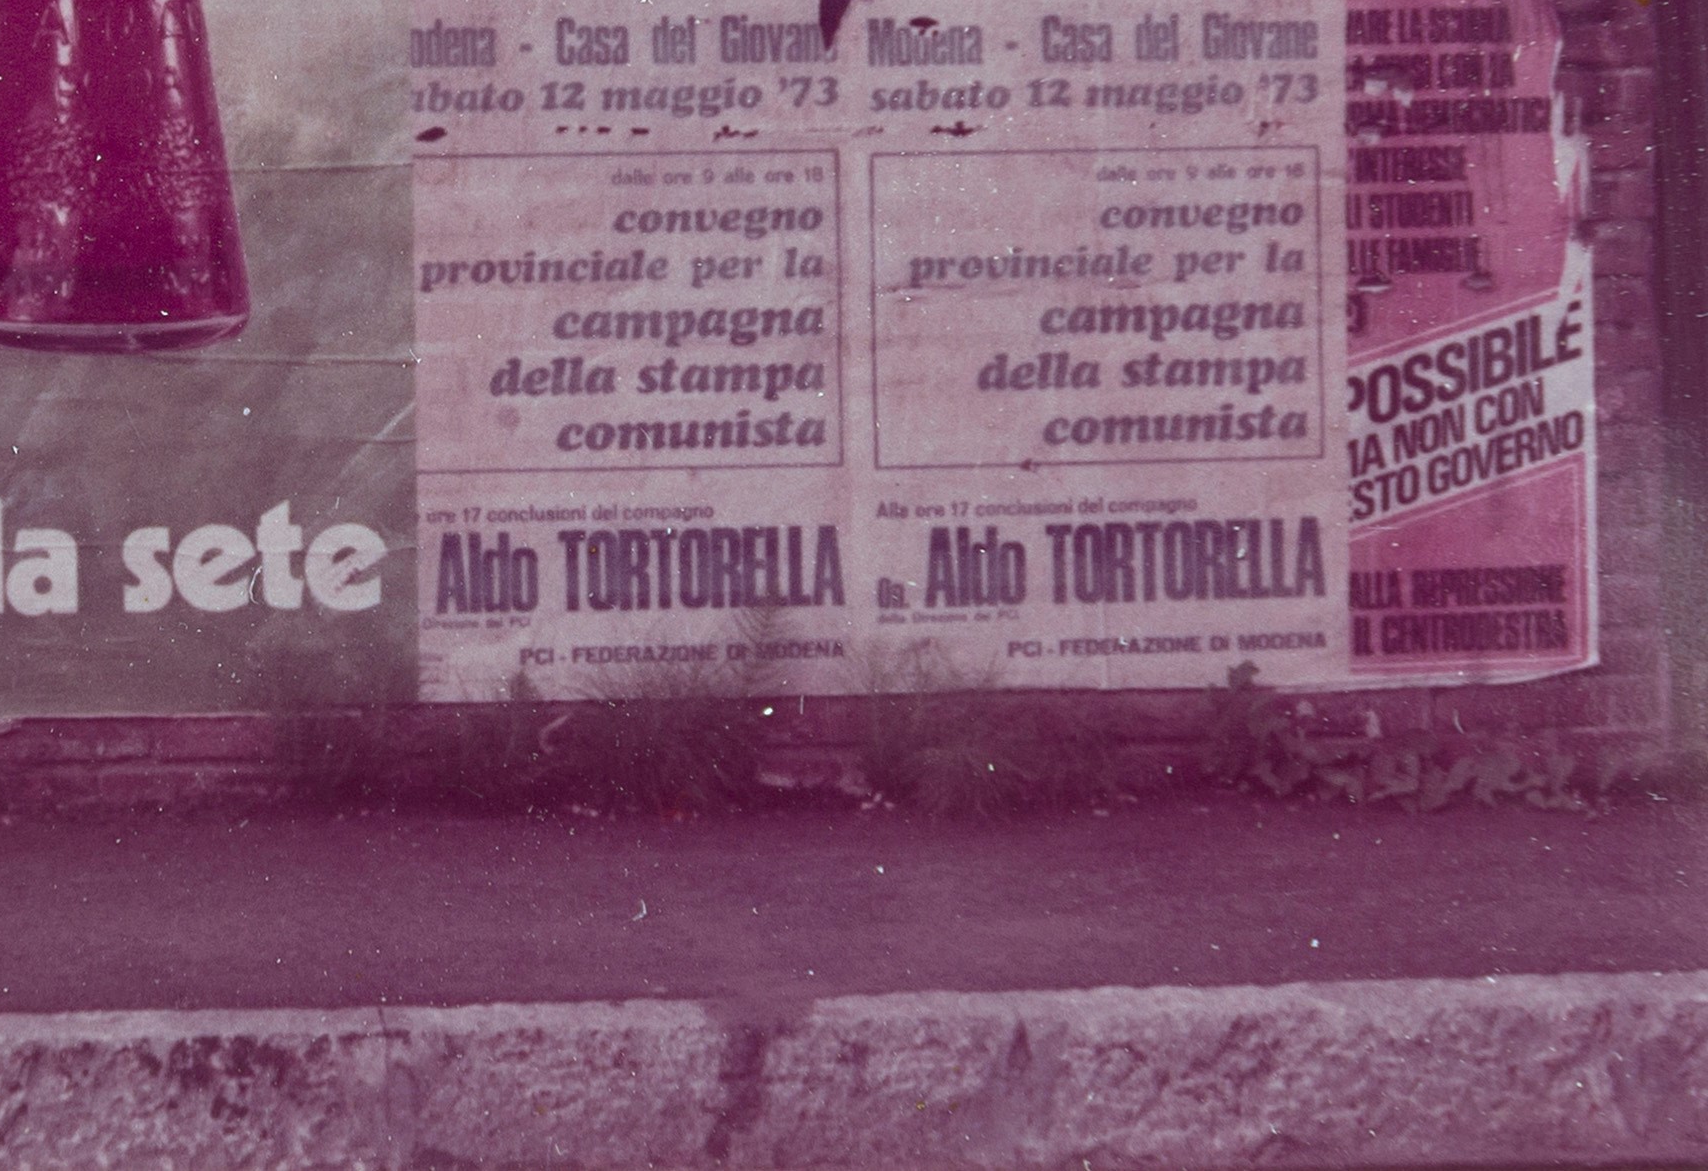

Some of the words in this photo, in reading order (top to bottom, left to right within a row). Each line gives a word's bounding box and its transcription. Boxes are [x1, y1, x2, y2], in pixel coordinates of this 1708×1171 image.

[555, 16, 629, 66] Casa
[652, 16, 696, 65] del
[1041, 15, 1113, 64] Casa
[1136, 14, 1179, 62] del
[1202, 12, 1318, 60] Giovane
[540, 81, 586, 111] 12
[602, 79, 763, 117] maggio
[870, 80, 1011, 112] sabato
[1026, 78, 1071, 109] 12
[1085, 75, 1245, 114] maggio
[612, 205, 824, 239] convegno
[1100, 201, 1305, 235] convegno
[420, 250, 669, 293] provinciale
[691, 254, 763, 289] per
[784, 247, 824, 279] la
[910, 245, 1153, 289] provinciale
[1174, 250, 1245, 283] per
[1266, 240, 1305, 273] la
[553, 306, 825, 347] campagna
[1040, 300, 1305, 341] campagna
[490, 357, 616, 397] della
[637, 358, 826, 402] stampa
[977, 352, 1101, 391] della
[1121, 353, 1306, 395] stampa
[556, 409, 827, 451] comunista
[1043, 403, 1307, 446] comunista
[1394, 404, 1465, 464] NON
[1474, 377, 1544, 436] CON
[1350, 464, 1420, 522] STO
[1427, 410, 1584, 496] GOVERNO
[487, 505, 587, 523] conclusioni
[592, 505, 618, 521] del
[621, 504, 714, 523] compagno
[975, 500, 1073, 517] conclusioni
[1078, 498, 1103, 514] del
[1108, 498, 1198, 516] compagno
[121, 499, 388, 613] sete
[436, 531, 539, 614] Aldo
[557, 525, 846, 612] TORTORELLA
[924, 526, 1027, 608] Aldo
[1045, 516, 1326, 604] TORTORELLA
[520, 647, 554, 666] PCI
[571, 644, 718, 663] FEDERAZIONE
[1008, 641, 1043, 657] PCI
[1060, 635, 1202, 656] FEDERAZIONE
[1238, 632, 1326, 651] MODENA
